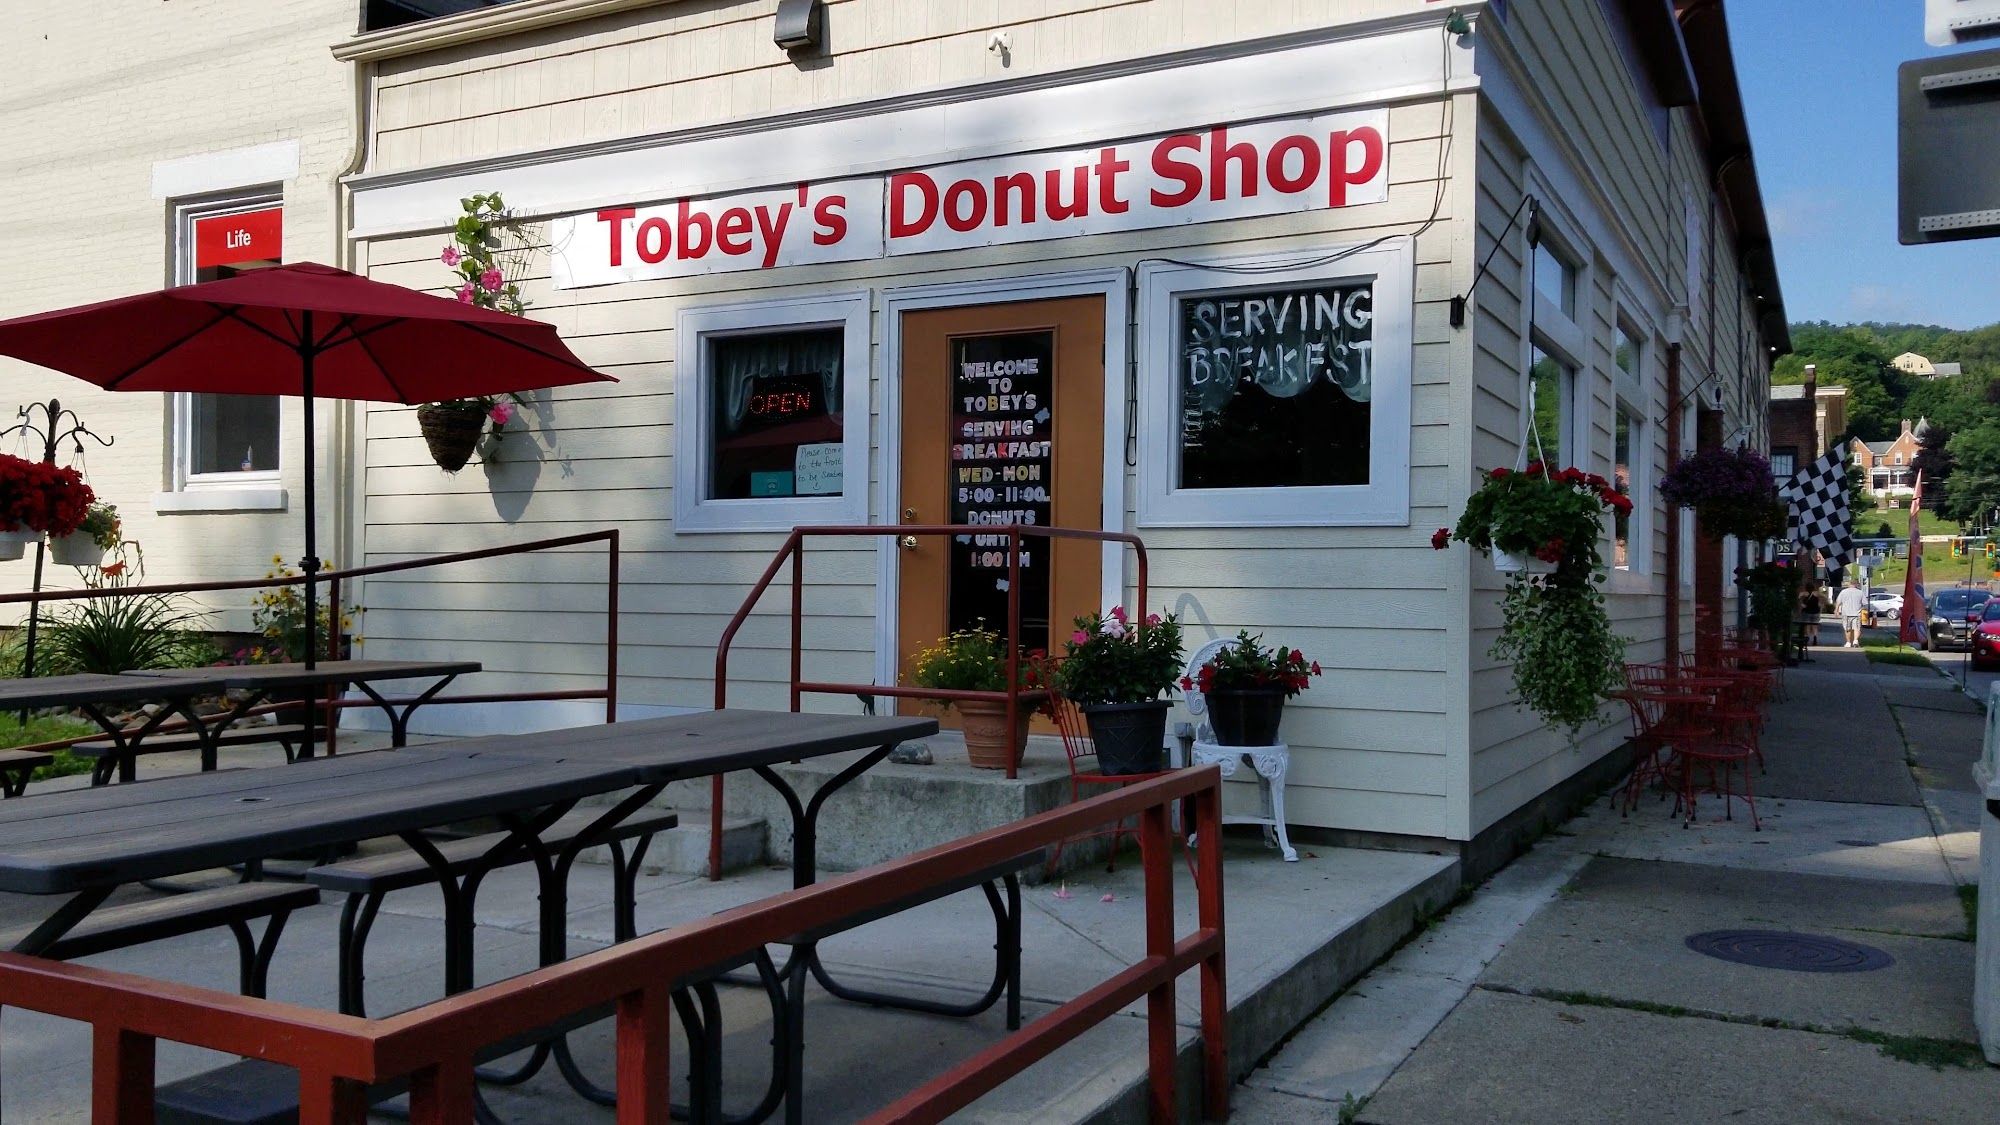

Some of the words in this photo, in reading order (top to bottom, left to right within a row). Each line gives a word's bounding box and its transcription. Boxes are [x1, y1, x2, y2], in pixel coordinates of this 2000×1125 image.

[597, 183, 847, 268] Tobey's
[889, 147, 1130, 239] Donut
[1150, 125, 1384, 208] Shop
[226, 229, 251, 248] Life
[1192, 288, 1372, 342] SERVING
[964, 358, 1038, 378] WELCOME
[988, 378, 1012, 394] TO
[749, 391, 811, 414] OPEN
[963, 391, 1036, 412] TOBEY'S
[963, 420, 1034, 437] SERVING
[800, 447, 820, 458] Please
[825, 447, 842, 455] come
[953, 441, 1051, 460] BREAKFAST
[798, 462, 806, 470] to
[810, 460, 822, 468] the
[824, 456, 842, 466] front
[809, 473, 817, 481] be
[967, 510, 1036, 525] DONUTS
[970, 552, 1003, 567] 1:00
